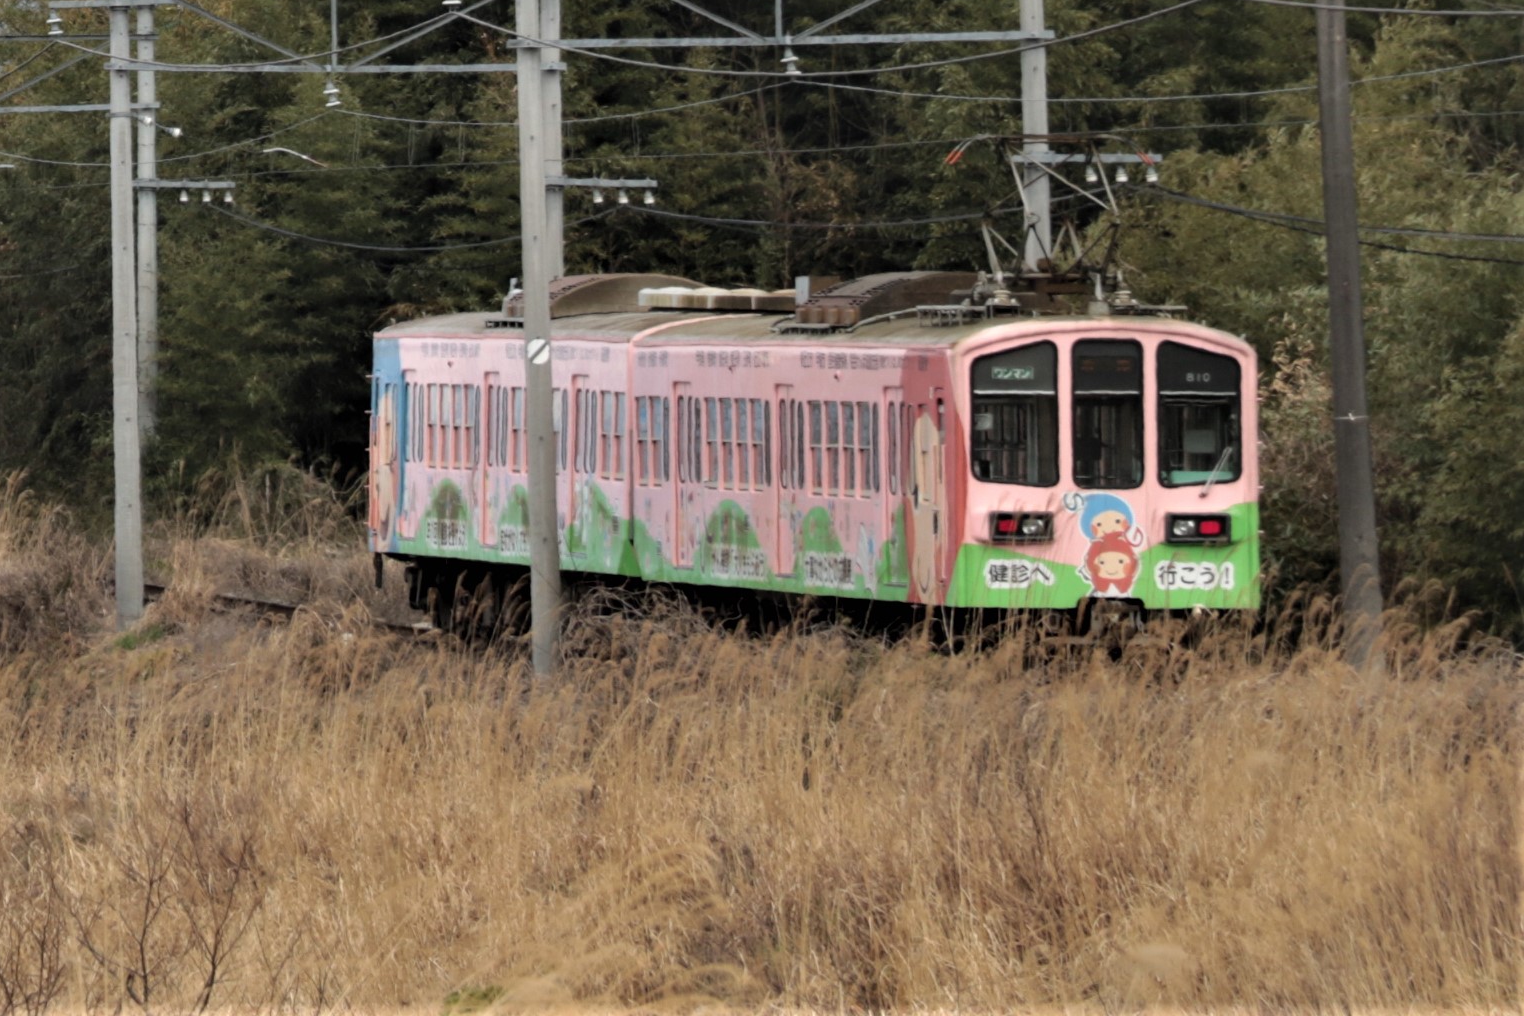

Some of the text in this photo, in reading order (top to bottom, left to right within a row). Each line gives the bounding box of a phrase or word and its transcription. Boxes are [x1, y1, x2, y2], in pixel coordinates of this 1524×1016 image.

[992, 367, 1031, 379] ワンマン
[1187, 372, 1211, 382] 810
[988, 564, 1051, 584] 健診へ
